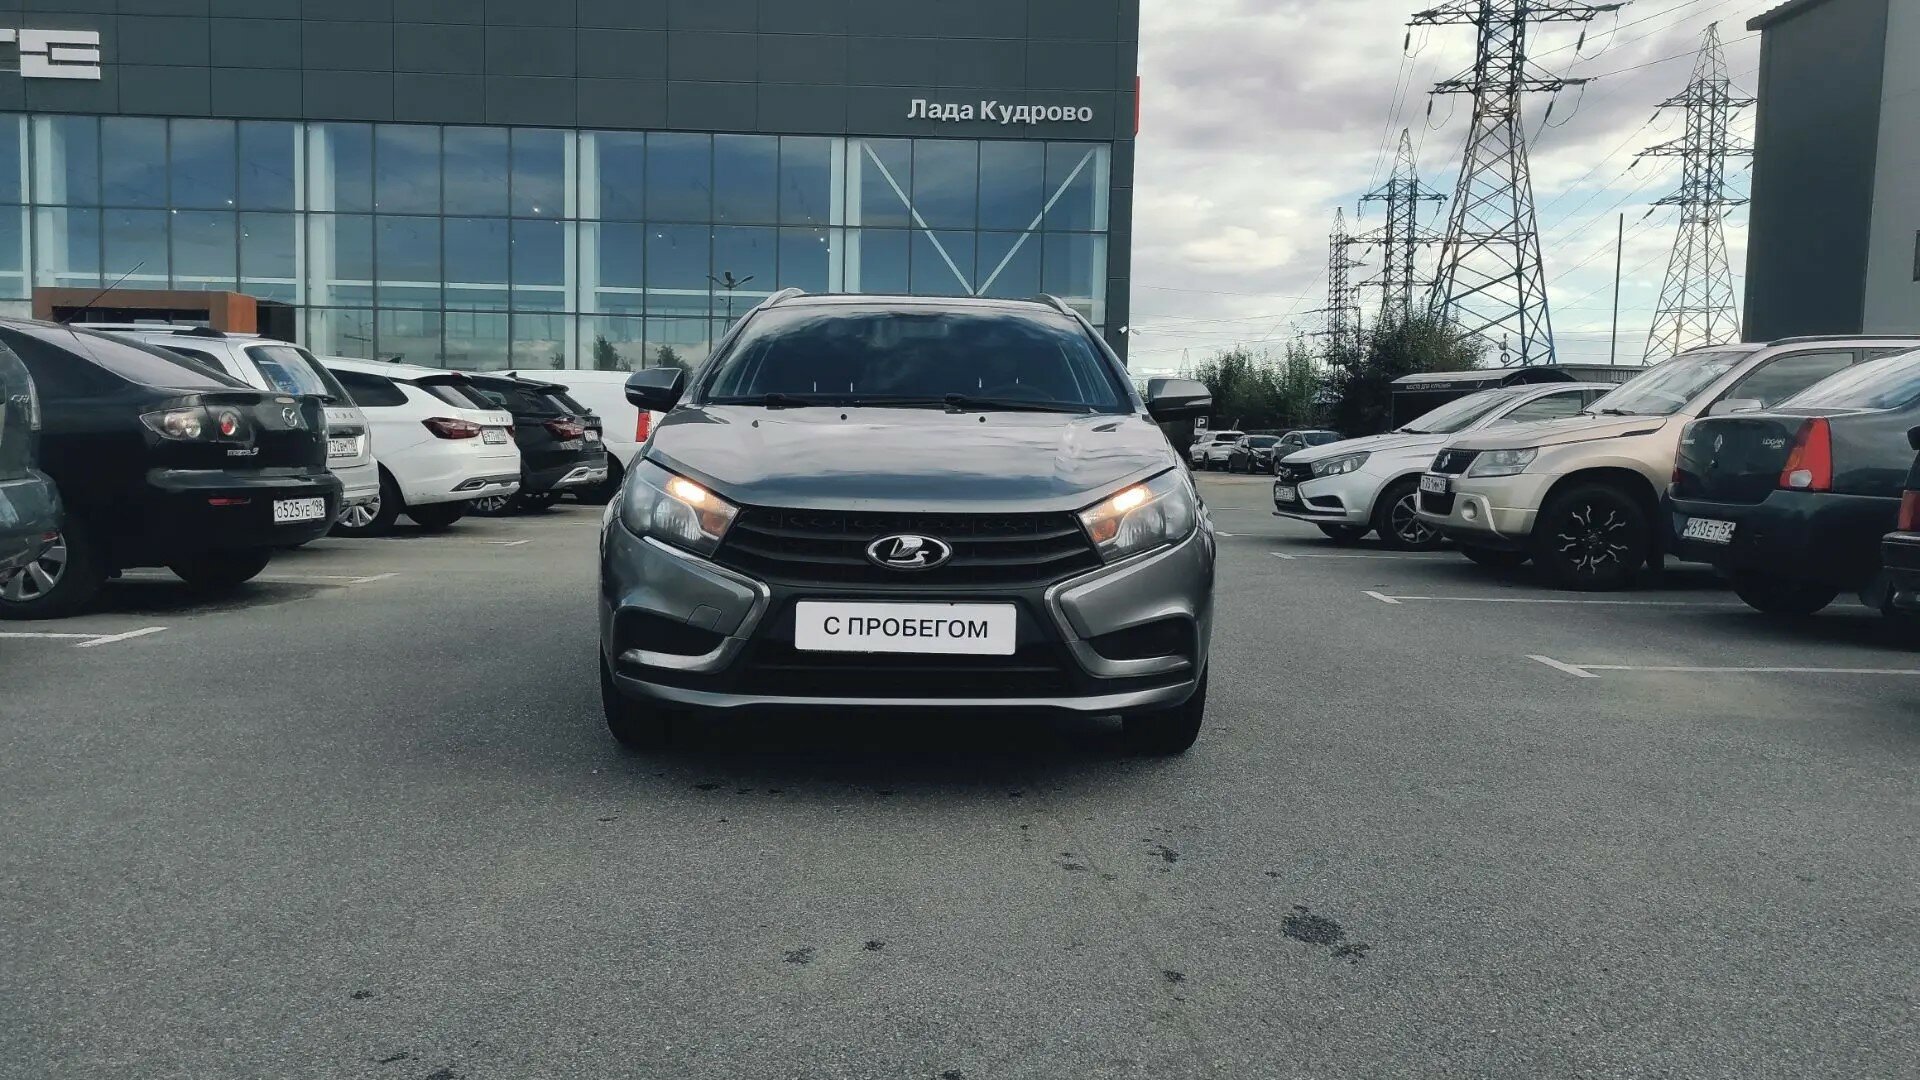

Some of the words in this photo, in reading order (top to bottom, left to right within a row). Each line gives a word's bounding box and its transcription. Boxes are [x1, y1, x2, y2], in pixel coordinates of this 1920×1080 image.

[907, 99, 974, 121] Лада
[980, 100, 1093, 124] Кудрово
[824, 616, 840, 635] С
[848, 616, 988, 638] ПРОБЕГОМ
